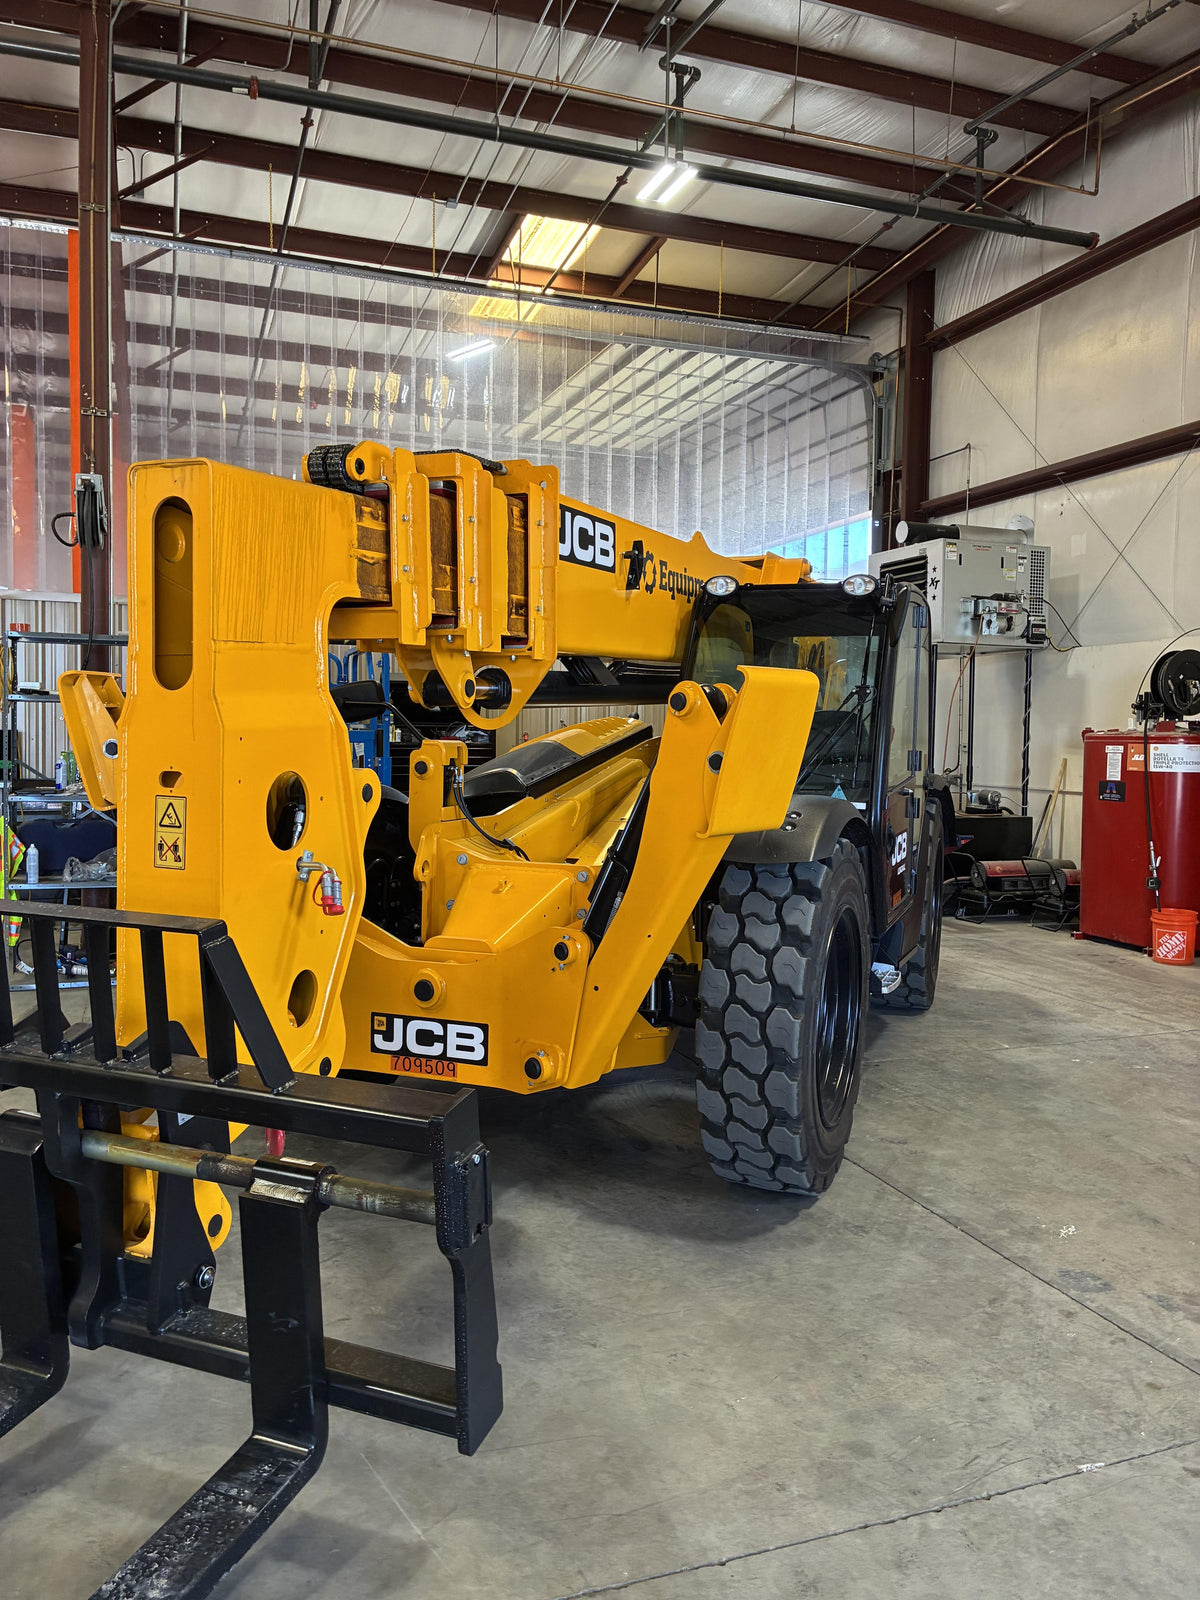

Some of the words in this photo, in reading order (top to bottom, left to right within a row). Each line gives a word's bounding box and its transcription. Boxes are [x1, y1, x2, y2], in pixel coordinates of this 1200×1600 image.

[559, 511, 614, 567] JCB
[659, 560, 704, 603] Equipm
[929, 577, 940, 590] XT
[892, 832, 907, 866] JCB
[1157, 931, 1187, 957] HOME
[1159, 933, 1171, 944] THE
[1167, 943, 1186, 959] DEPOT
[374, 1018, 485, 1061] JCB
[391, 1056, 456, 1077] 709509
